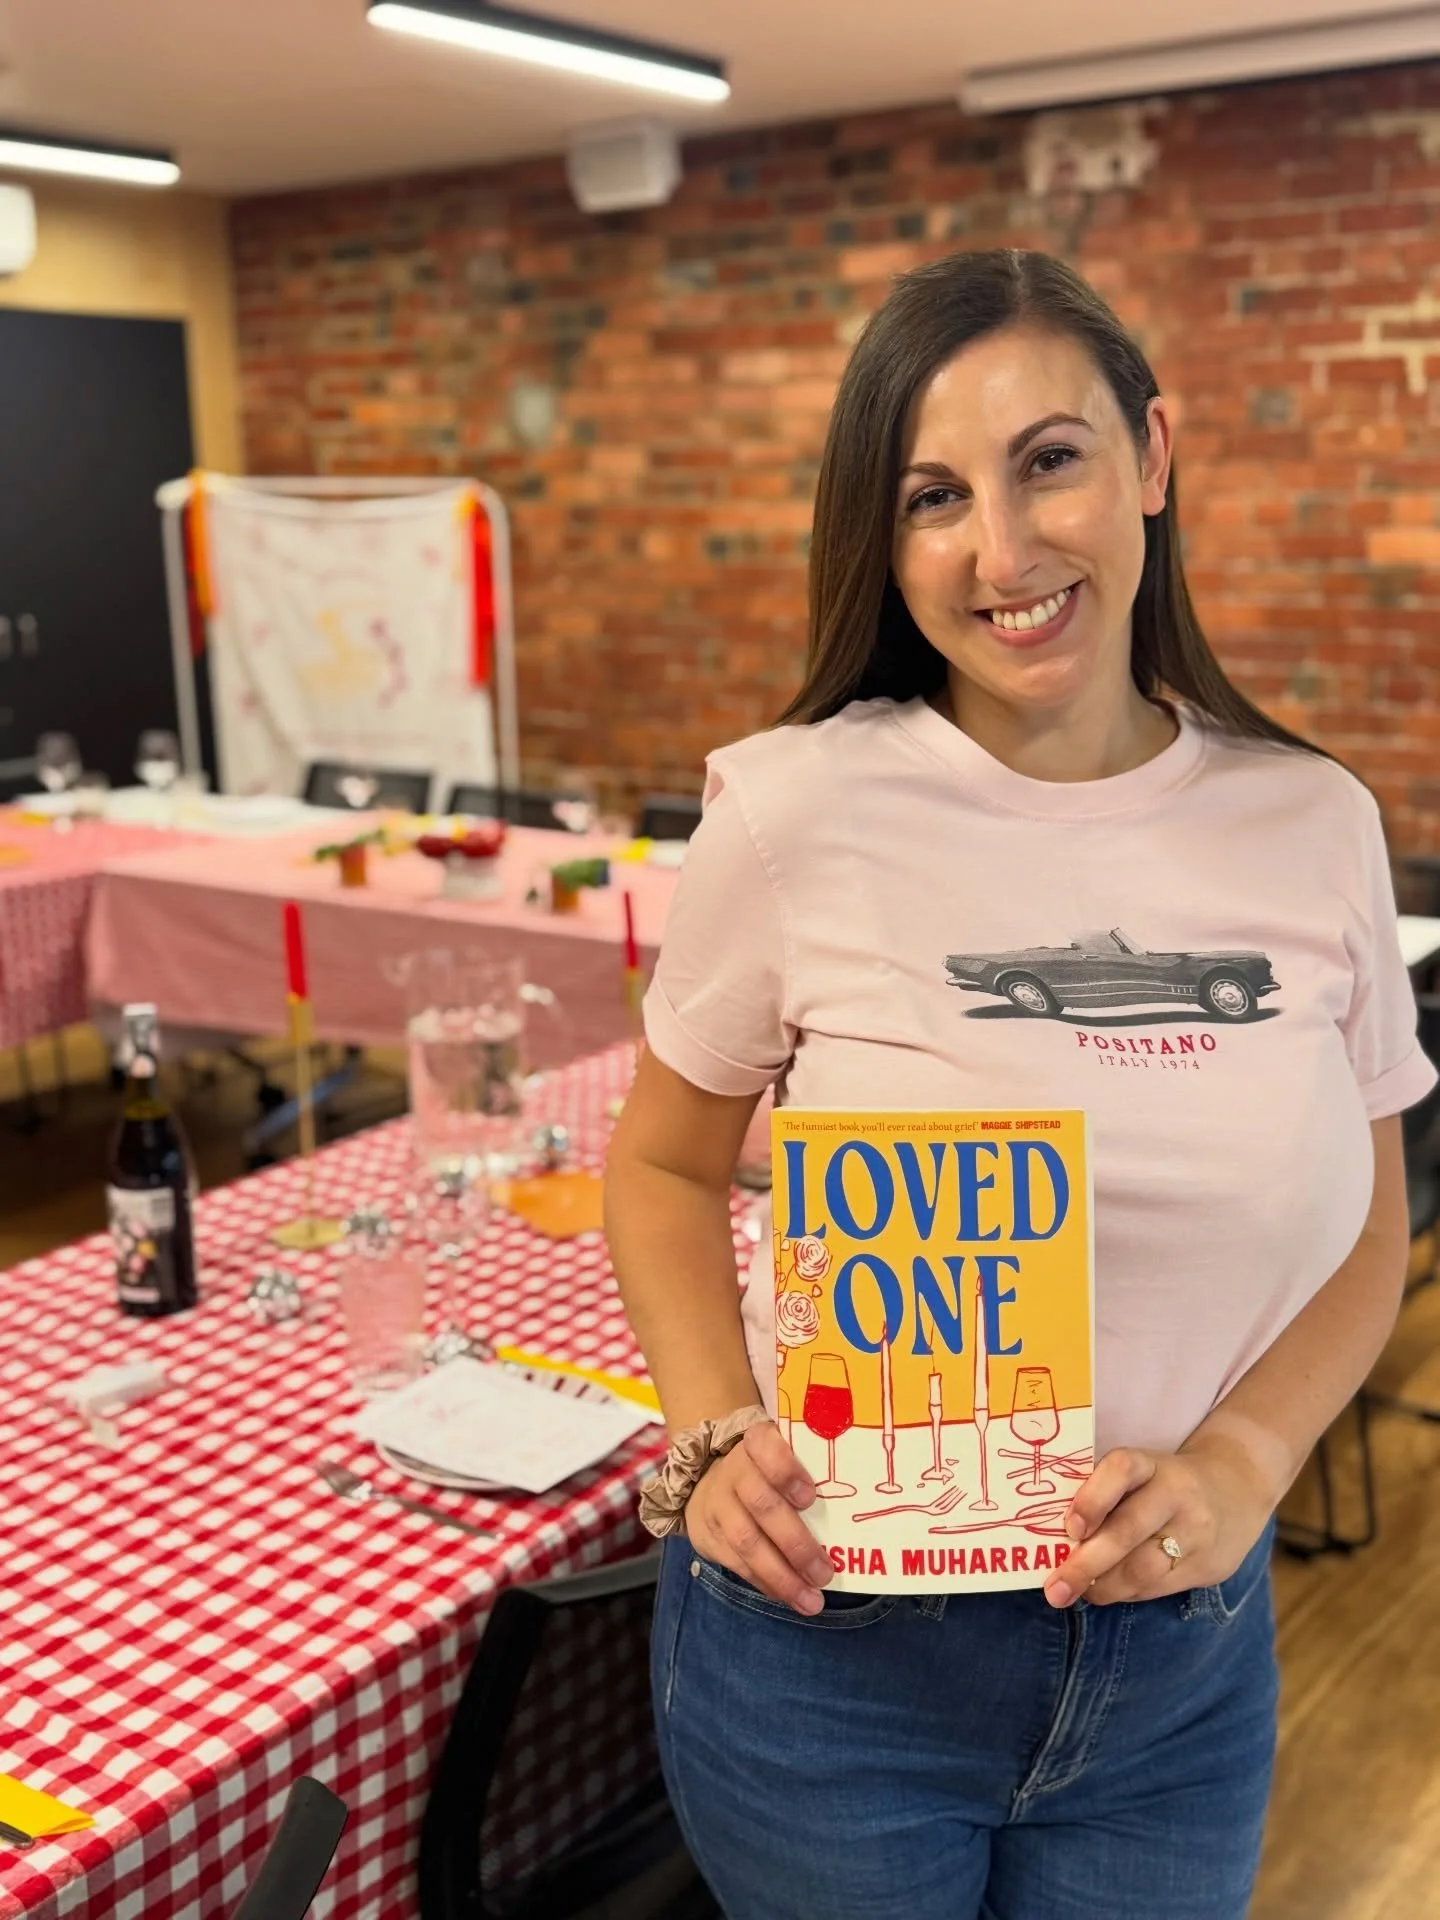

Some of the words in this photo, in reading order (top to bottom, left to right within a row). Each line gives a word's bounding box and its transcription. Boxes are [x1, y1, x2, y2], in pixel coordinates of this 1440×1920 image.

[1075, 1031, 1216, 1055] POSITANO
[1098, 1054, 1149, 1068] ITALY
[1160, 1059, 1200, 1070] 1974
[802, 1121, 837, 1131] funniest
[839, 1121, 860, 1132] book
[861, 1121, 885, 1133] you'll
[887, 1123, 905, 1132] ever
[907, 1121, 927, 1131] read
[928, 1121, 953, 1131] about
[981, 1120, 1012, 1130] MAGGIE
[1015, 1120, 1061, 1130] SHIPSTEAD
[782, 1140, 1069, 1241] LOVED
[833, 1253, 1022, 1356] ONE
[821, 1544, 887, 1576] SHA
